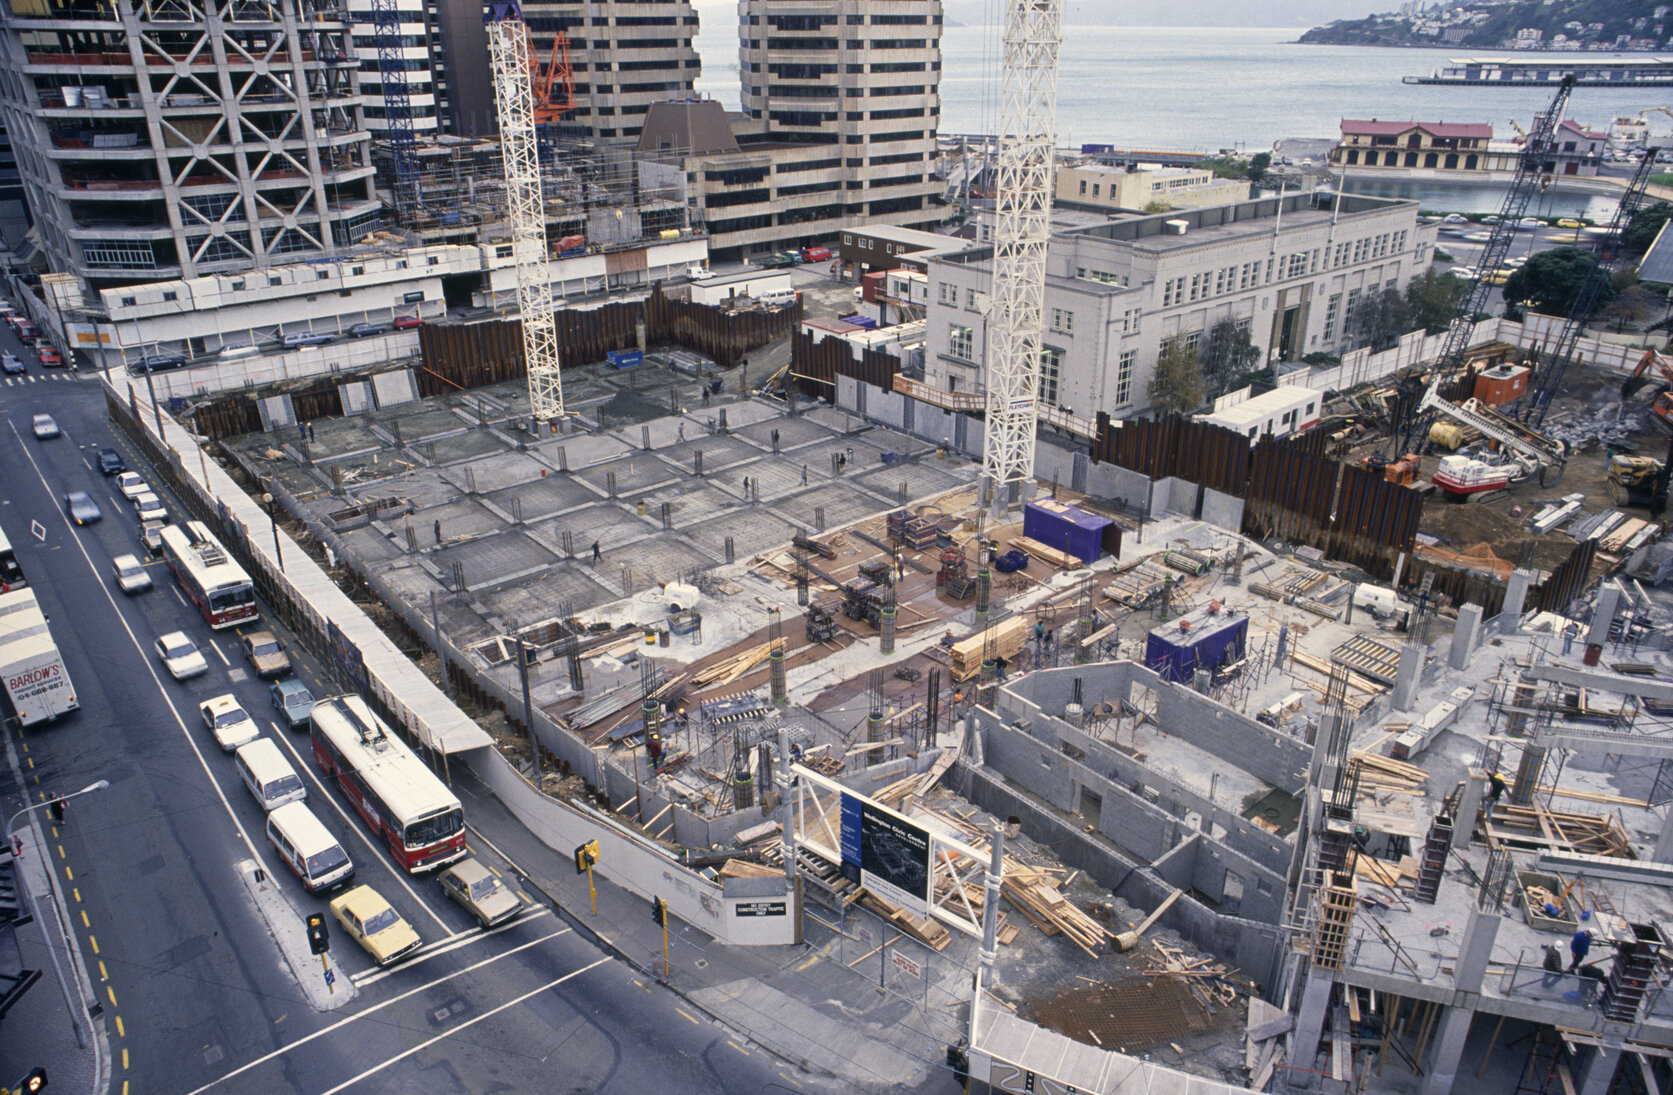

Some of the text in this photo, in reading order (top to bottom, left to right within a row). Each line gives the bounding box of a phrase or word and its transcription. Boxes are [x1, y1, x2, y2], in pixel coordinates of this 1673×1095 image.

[1008, 402, 1034, 410] FLETCHER
[10, 664, 60, 690] BARLOW'S
[863, 811, 891, 829] Wellington
[891, 826, 906, 837] Civic
[907, 833, 927, 847] Centre
